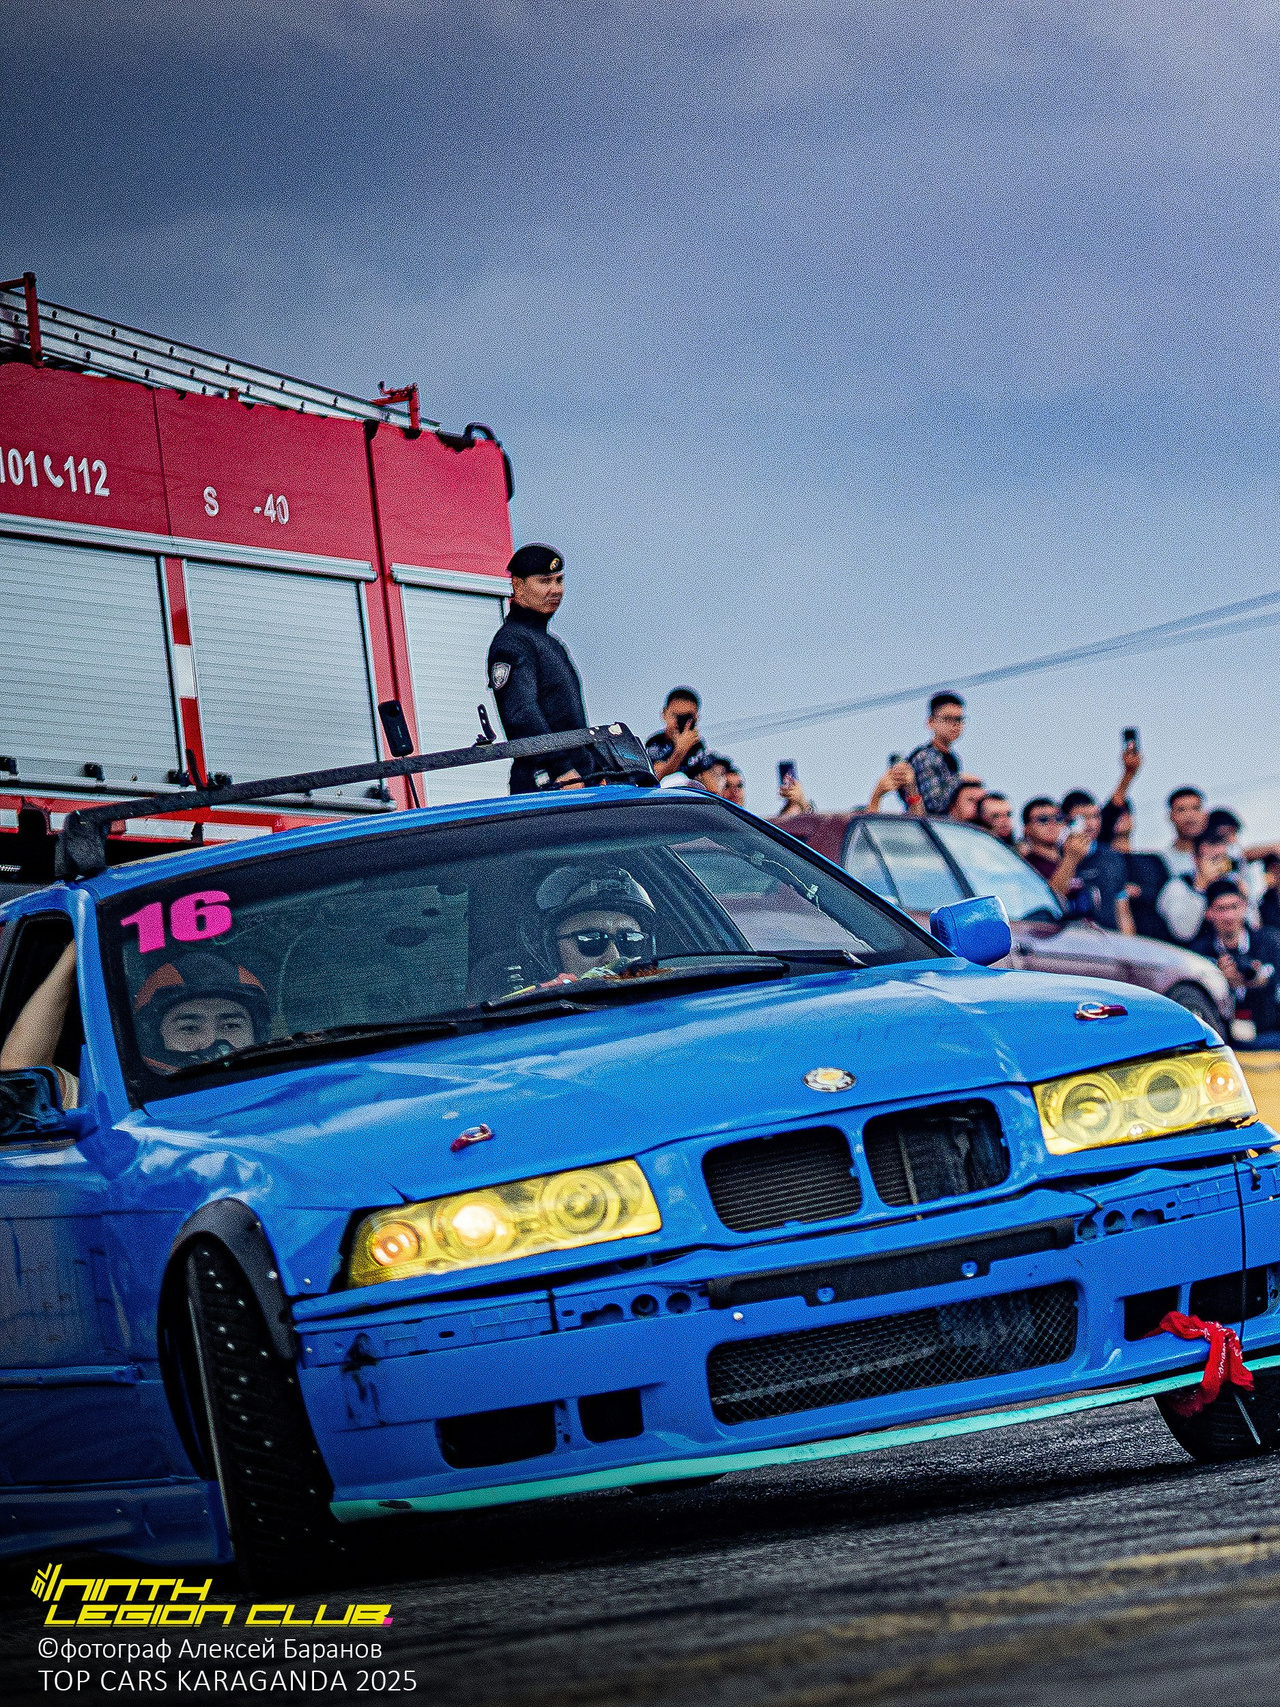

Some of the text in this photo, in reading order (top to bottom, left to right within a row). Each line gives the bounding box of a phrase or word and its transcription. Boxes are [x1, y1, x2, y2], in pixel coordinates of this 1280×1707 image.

[63, 455, 110, 497] 112
[203, 486, 219, 517] S
[120, 890, 232, 954] 16
